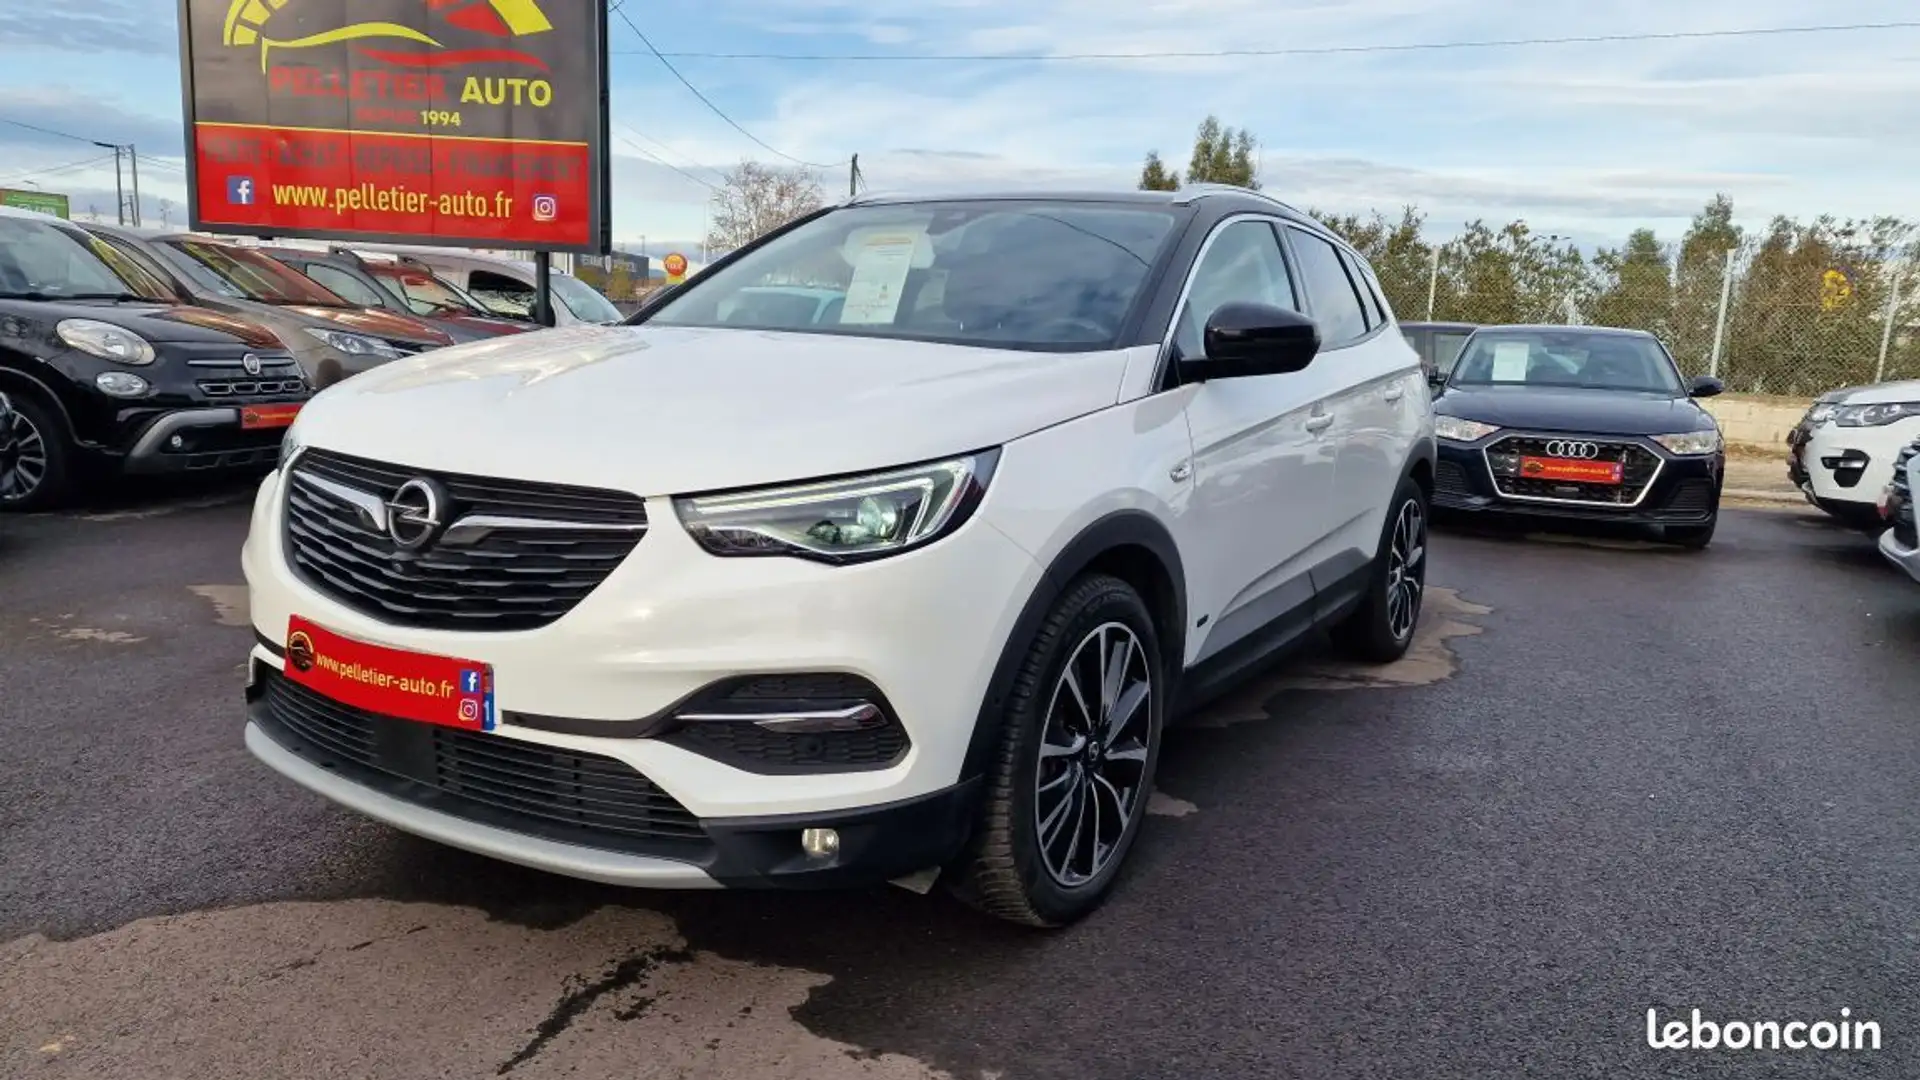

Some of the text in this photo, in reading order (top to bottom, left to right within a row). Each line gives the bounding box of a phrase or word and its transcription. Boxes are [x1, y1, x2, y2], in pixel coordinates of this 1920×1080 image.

[269, 66, 552, 107] PELLETIER AUTO
[420, 110, 462, 127] 1994
[272, 183, 513, 219] www.pelletier-auto.fr
[316, 652, 455, 699] www.pelletier-auto.fr
